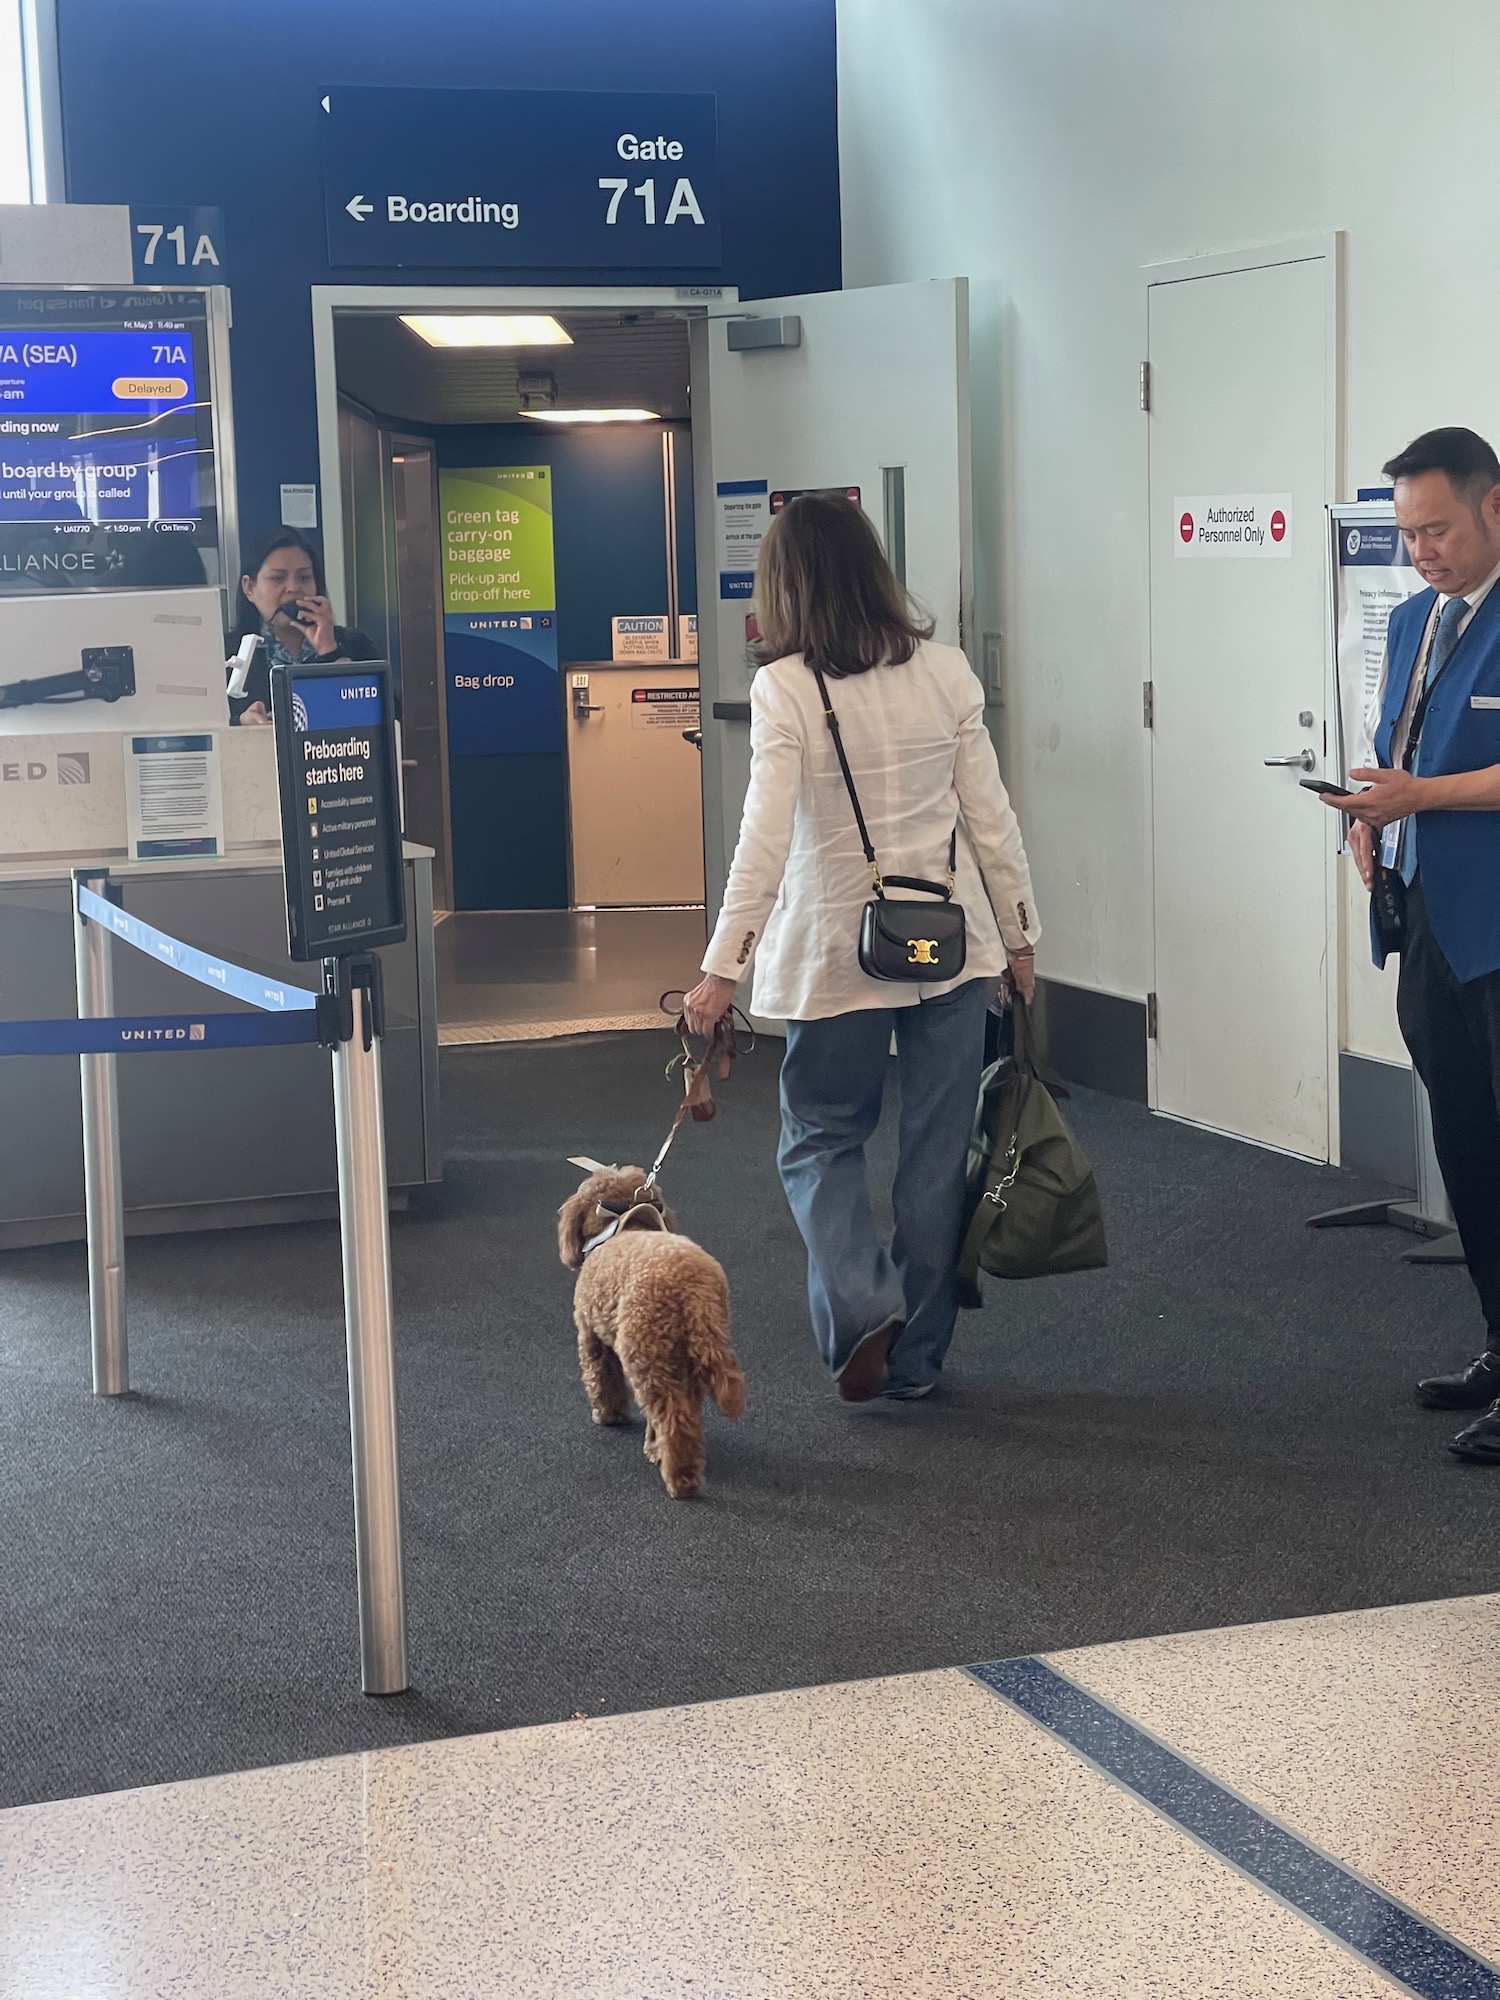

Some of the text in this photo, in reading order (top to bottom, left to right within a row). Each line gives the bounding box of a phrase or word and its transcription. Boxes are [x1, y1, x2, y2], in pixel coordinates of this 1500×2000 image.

[617, 134, 684, 161] Gate
[599, 178, 705, 225] 71A
[388, 196, 519, 229] Boarding
[137, 225, 219, 266] 71A
[148, 321, 154, 329] 3
[23, 343, 77, 368] (SEA)
[152, 346, 187, 364] 71A
[128, 383, 172, 395] Delayed
[0, 421, 60, 435] ding now
[2, 462, 137, 482] board by group
[3, 489, 26, 499] until
[28, 490, 52, 501] your
[54, 490, 86, 501] group
[98, 488, 130, 498] called
[447, 509, 519, 525] Green tag
[1207, 507, 1254, 523] Authorized
[113, 525, 128, 533] 1:50
[448, 529, 512, 544] carry-on
[1198, 526, 1264, 545] Personnel Only
[449, 548, 511, 562] baggage
[450, 571, 520, 586] Pick-up and
[729, 582, 753, 590] UNITED
[450, 587, 531, 602] drop-off here
[470, 620, 518, 629] UNITED
[618, 621, 663, 631] CAUTION
[455, 674, 514, 689] Bag drop
[341, 686, 377, 699] UNITED
[647, 692, 687, 700] RESTRICTED
[304, 736, 370, 760] Preboarding
[306, 762, 364, 785] starts here
[121, 1028, 186, 1040] UNITED
